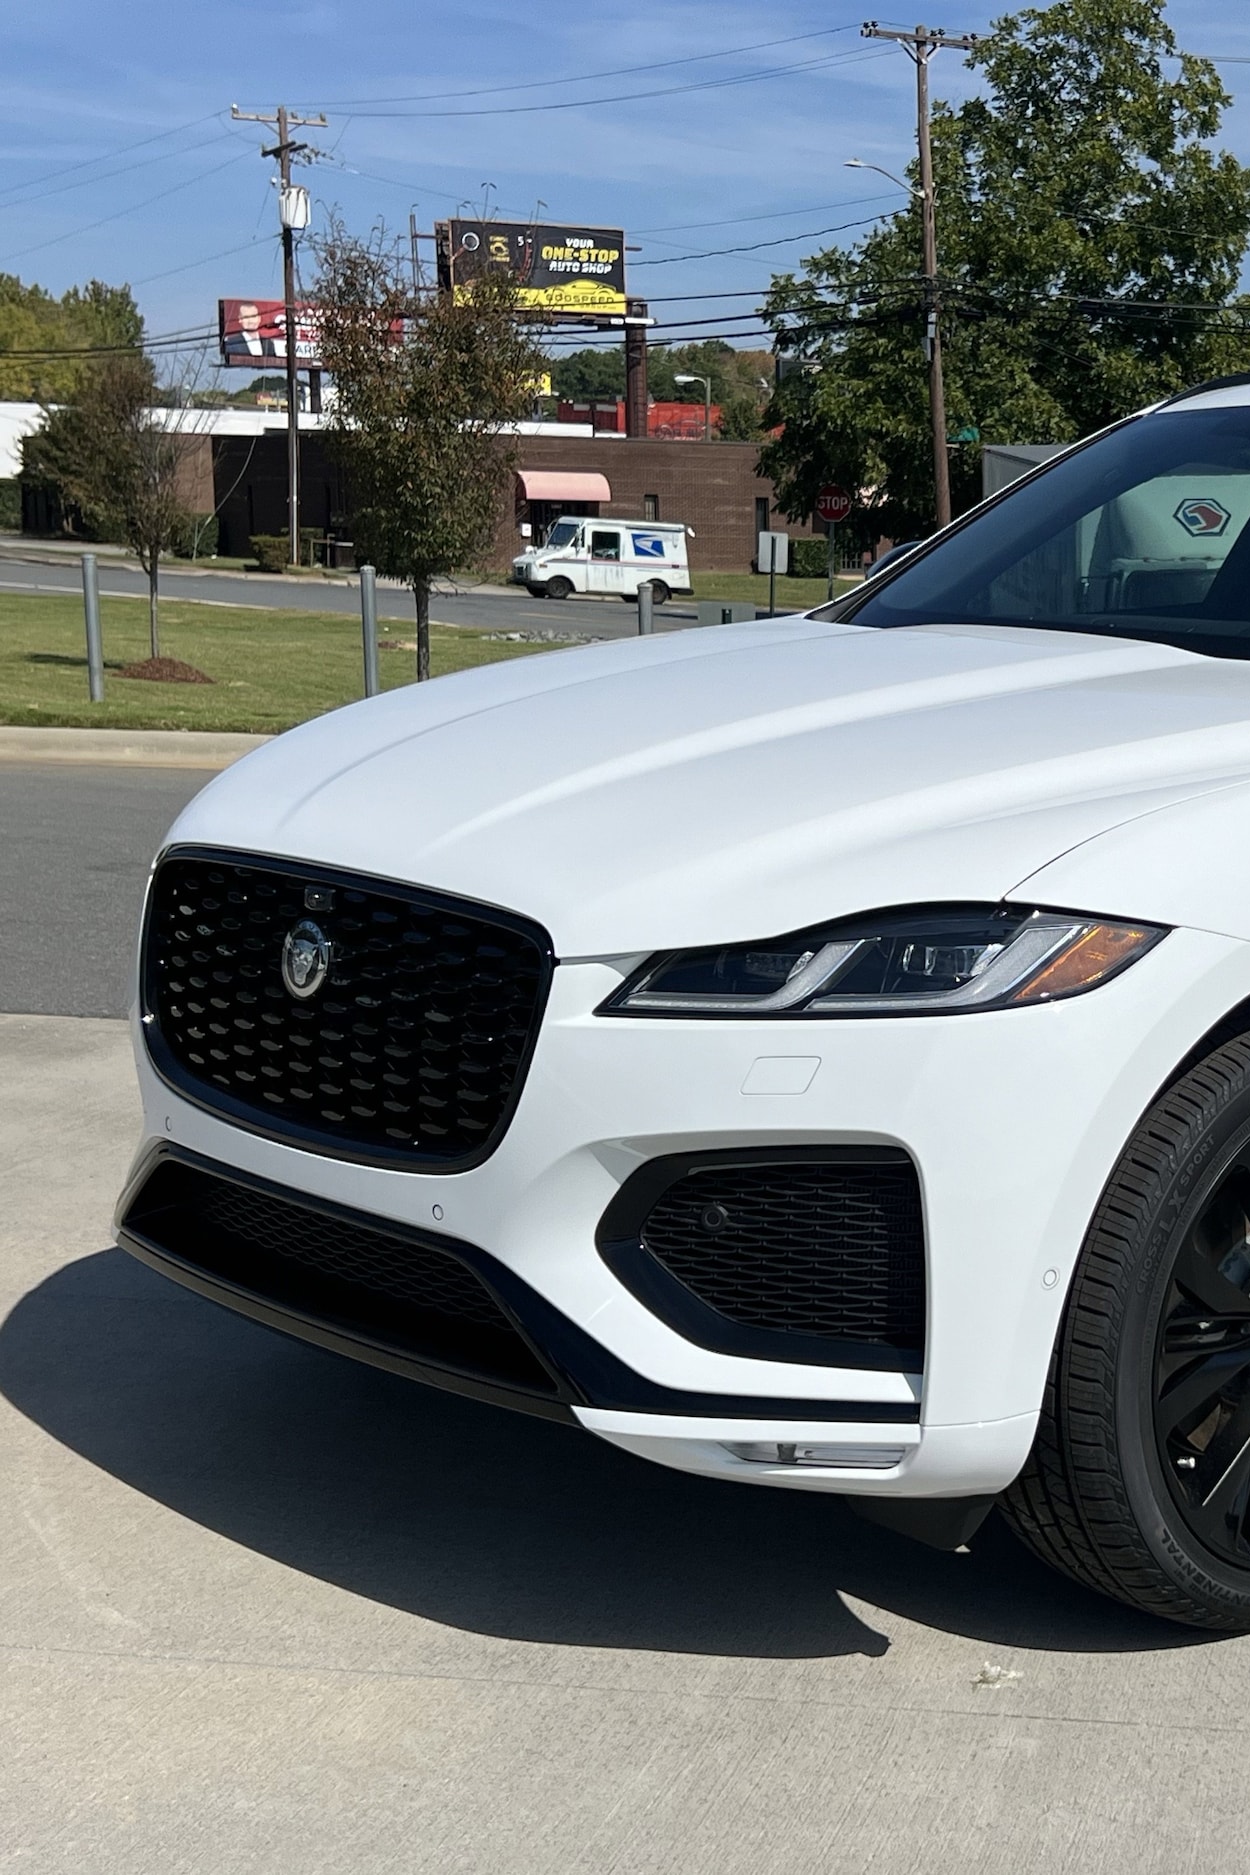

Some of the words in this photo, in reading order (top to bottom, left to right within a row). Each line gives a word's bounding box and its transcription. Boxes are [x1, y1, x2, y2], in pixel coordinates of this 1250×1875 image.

[565, 238, 594, 248] YOUR
[542, 246, 619, 263] ONE-STOP
[549, 261, 580, 272] AUTO
[581, 262, 612, 274] SHOP
[818, 495, 848, 510] STOP
[1135, 1233, 1163, 1294] CROSS
[1180, 1133, 1215, 1187] SPORT
